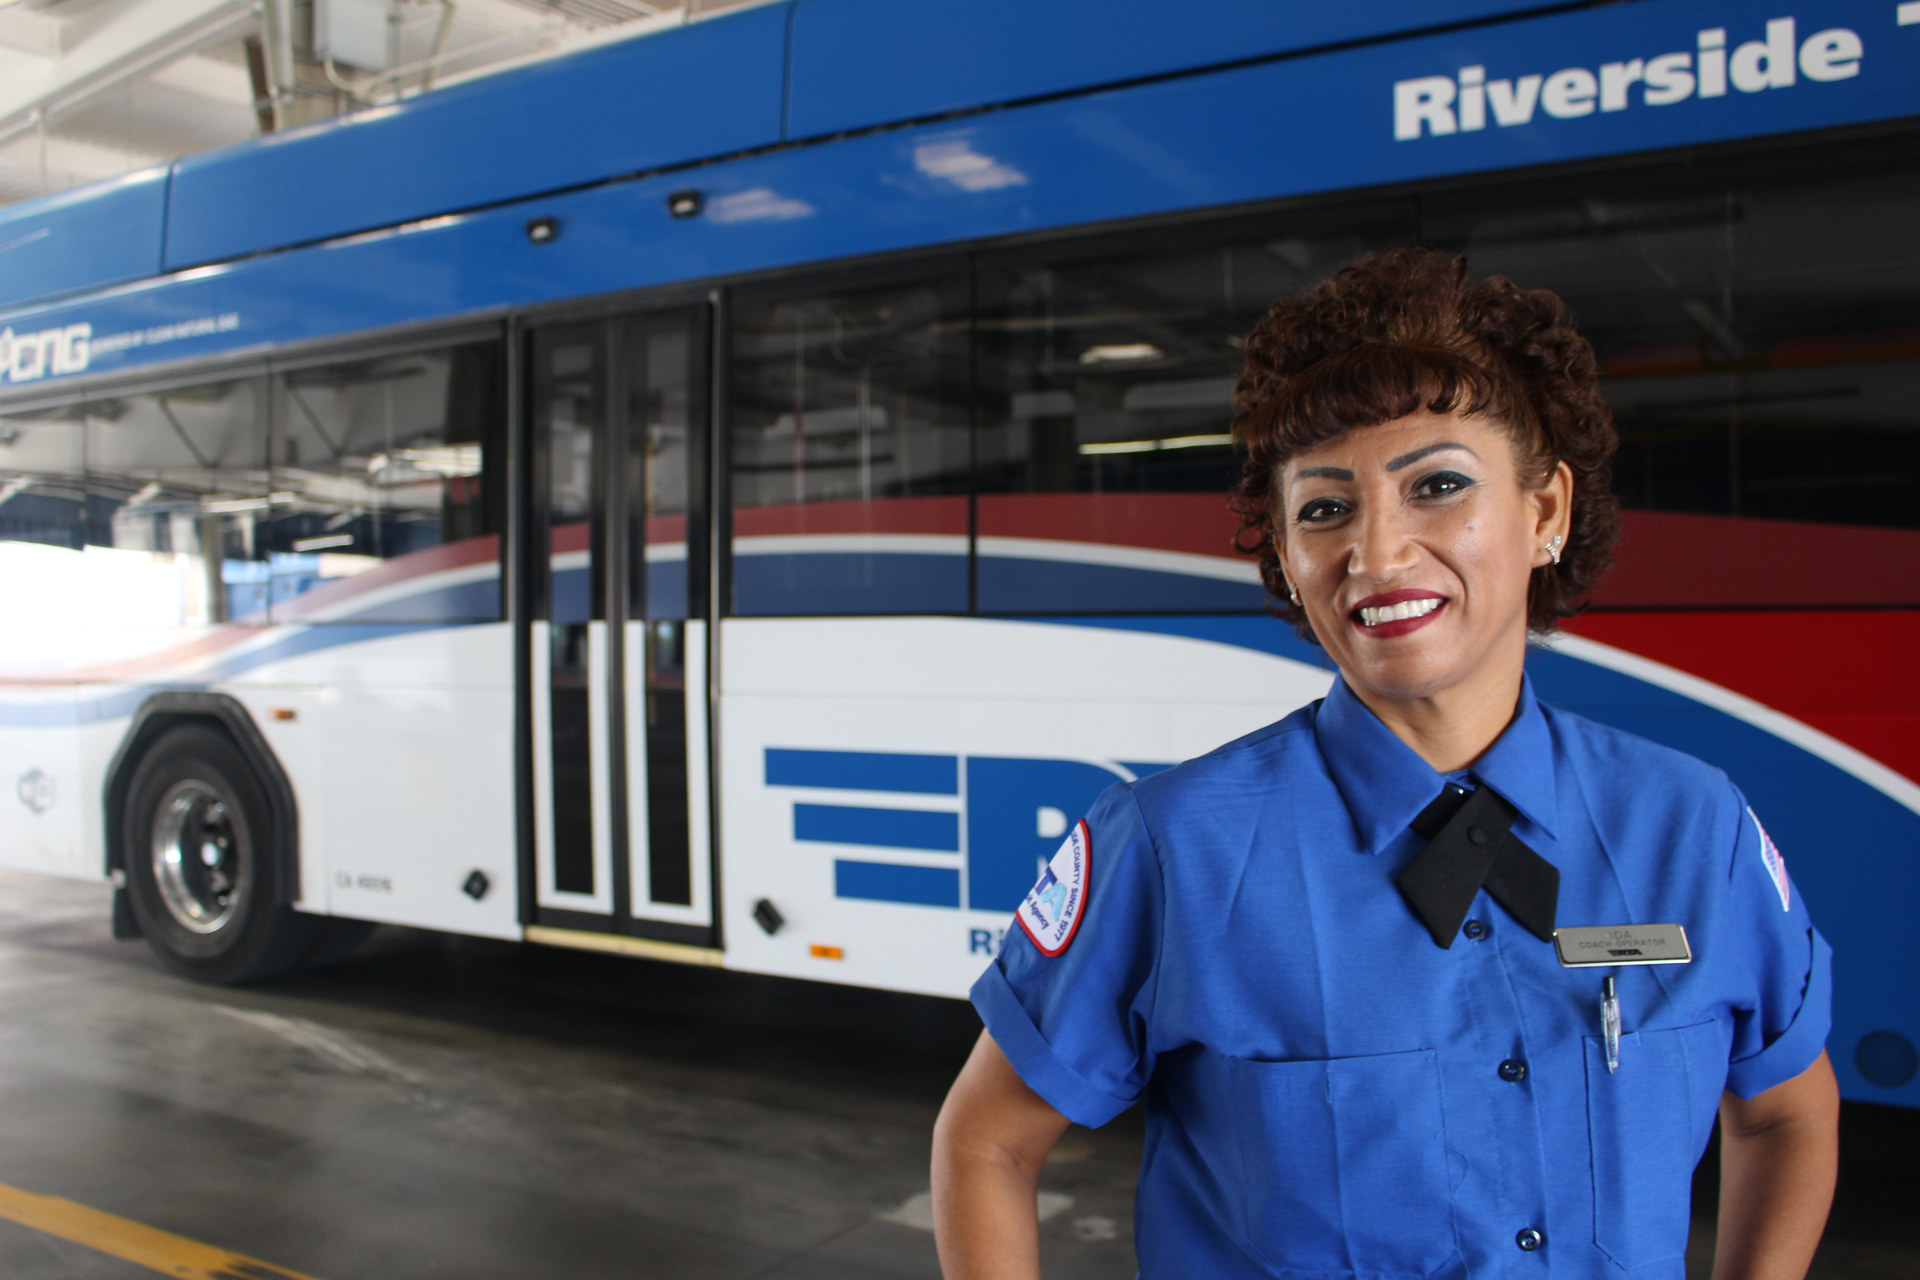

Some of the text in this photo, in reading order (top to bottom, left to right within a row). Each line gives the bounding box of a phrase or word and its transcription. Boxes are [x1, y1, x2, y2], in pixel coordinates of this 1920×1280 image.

[1394, 16, 1864, 142] Riverside
[1072, 846, 1080, 885] COUNTY
[1065, 888, 1079, 918] SINCE
[1055, 921, 1069, 941] 1977
[1608, 930, 1632, 940] IDA
[1579, 939, 1666, 949] COACH OPERATOR
